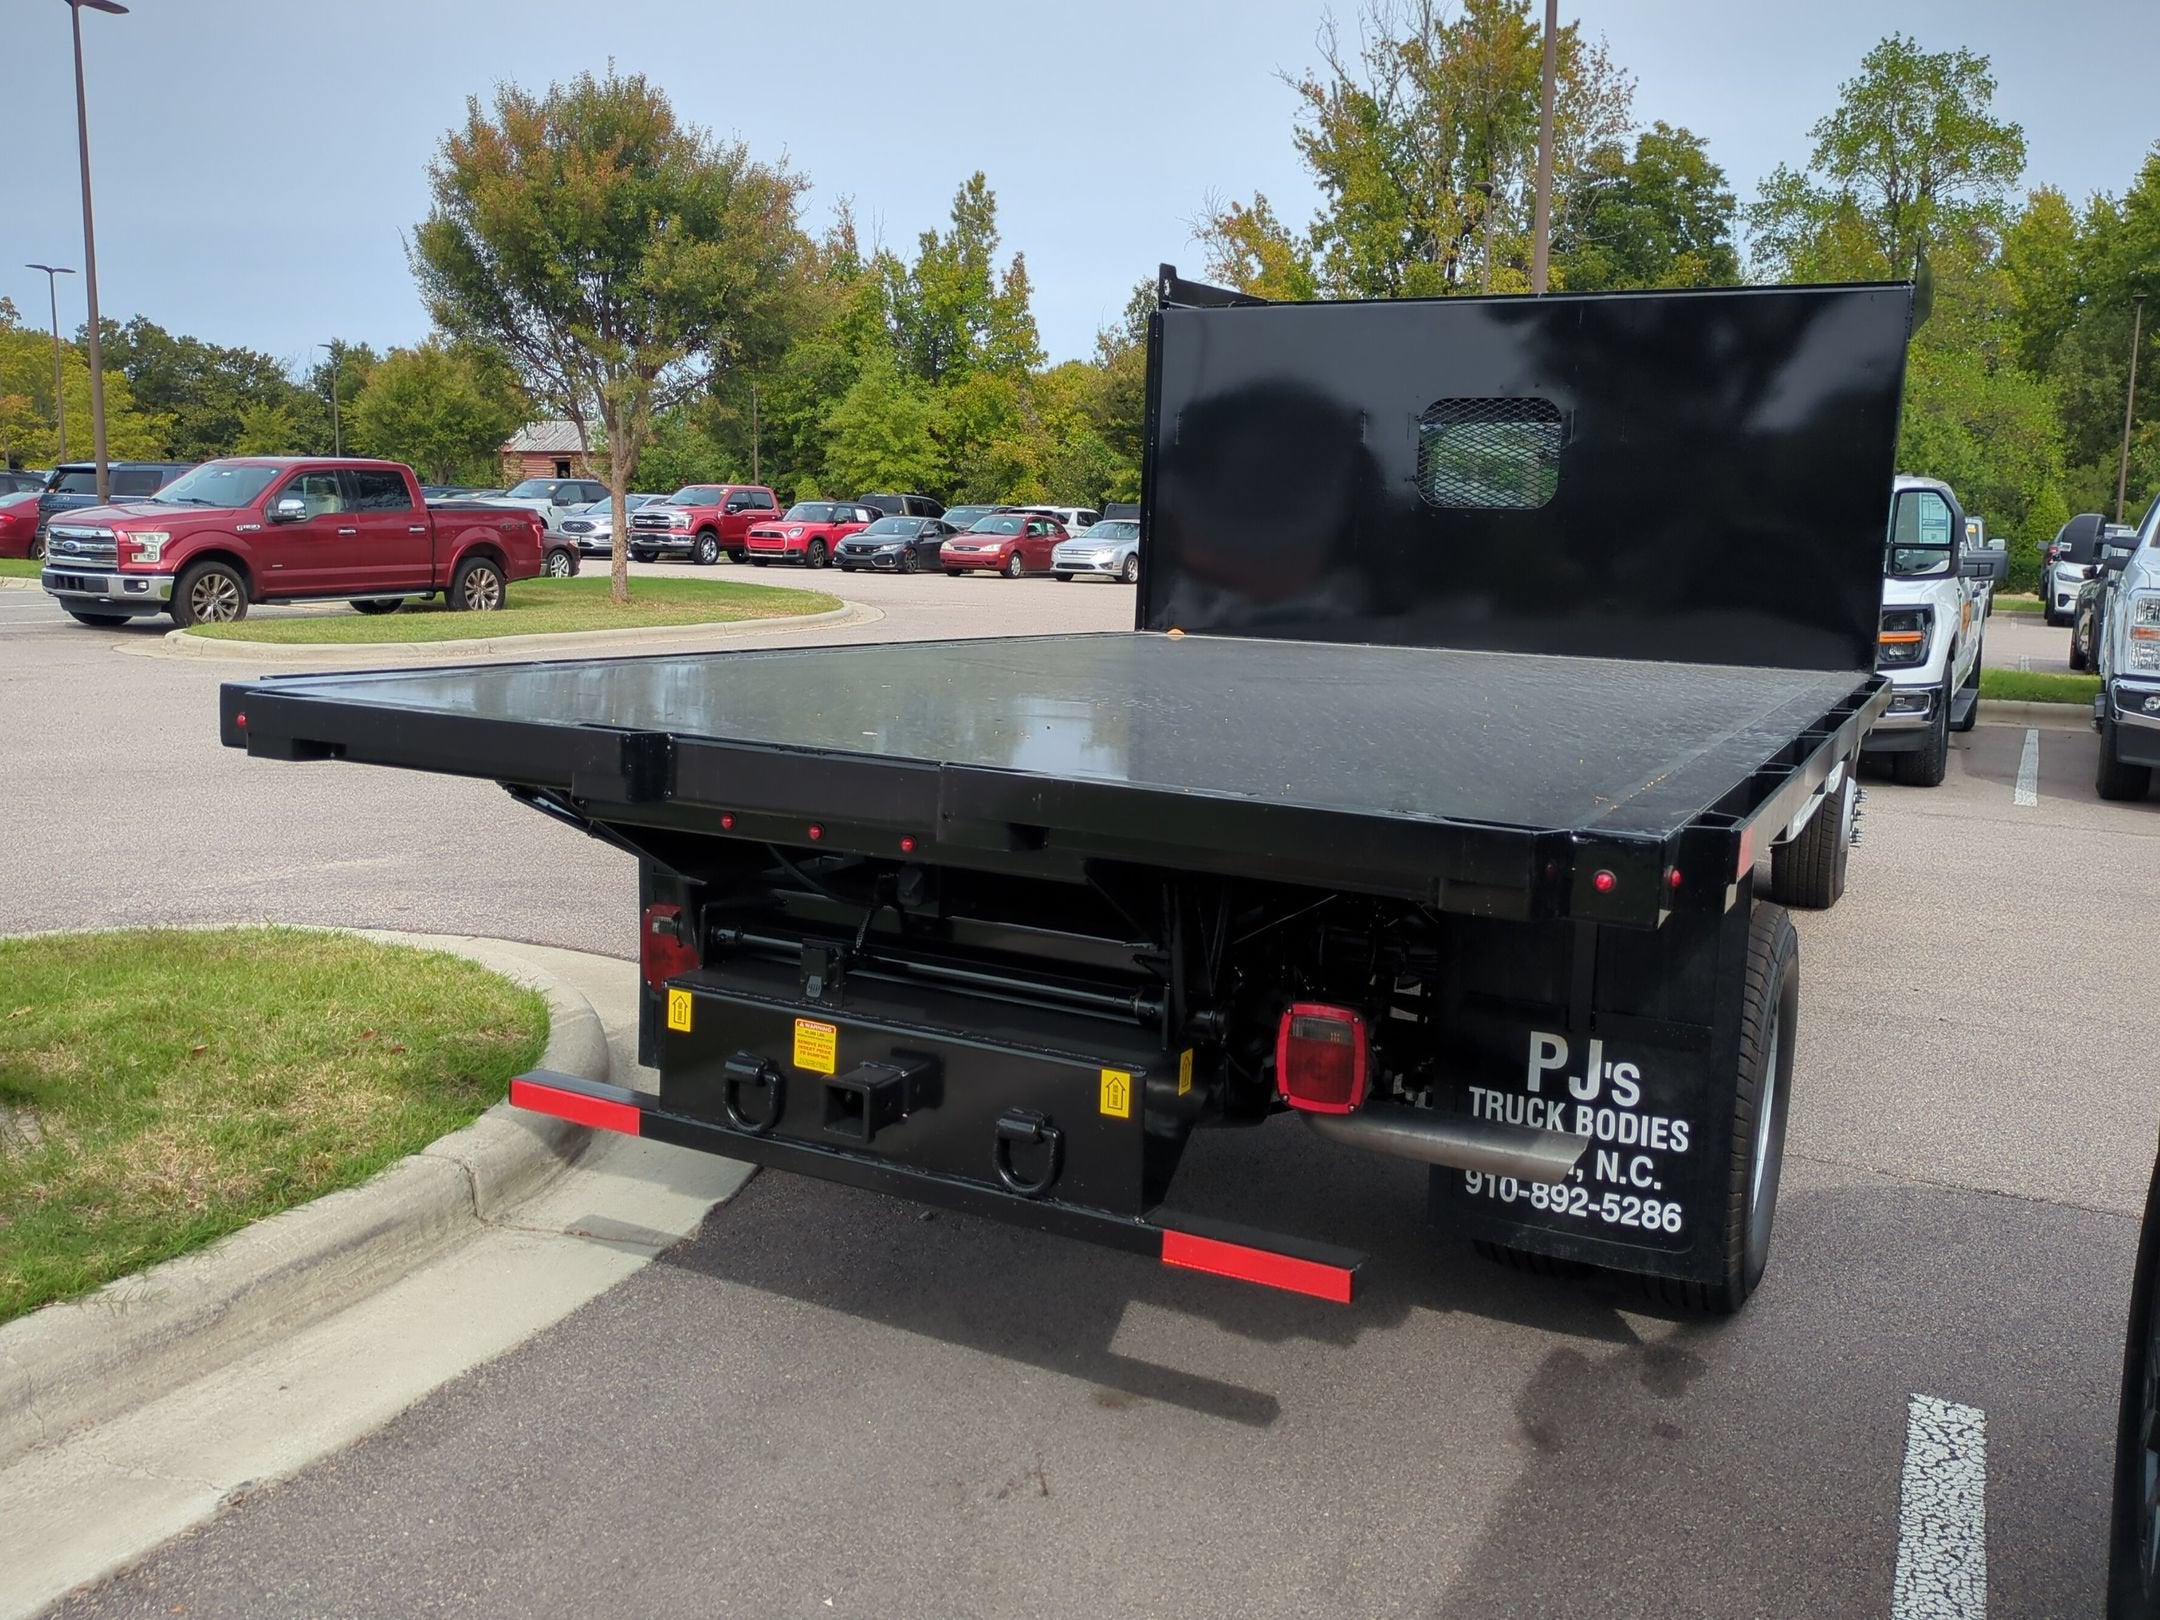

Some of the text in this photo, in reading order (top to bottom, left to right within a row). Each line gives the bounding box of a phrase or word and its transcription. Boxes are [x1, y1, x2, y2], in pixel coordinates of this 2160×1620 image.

[1469, 1086, 1689, 1152] TRUCK BODIES
[1465, 1169, 1682, 1232] 910-892-5286
[1596, 1149, 1661, 1190] N.C.
